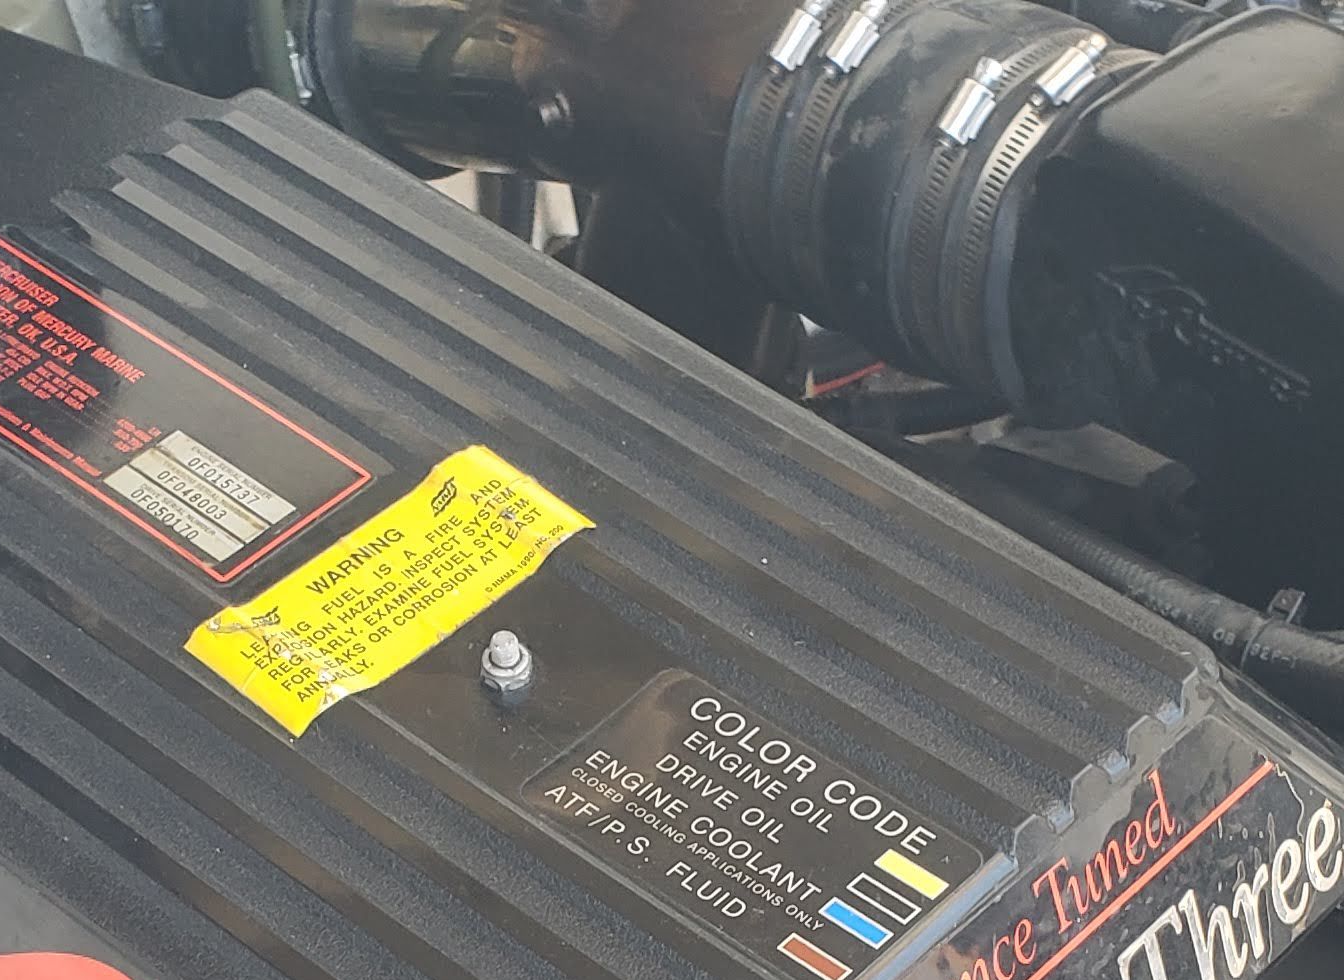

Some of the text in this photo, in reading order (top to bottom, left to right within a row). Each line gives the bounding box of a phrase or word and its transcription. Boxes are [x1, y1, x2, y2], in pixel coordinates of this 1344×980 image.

[13, 297, 37, 313] OF
[32, 310, 95, 350] MERCURY
[91, 347, 144, 382] MARINE
[39, 337, 78, 366] U.S.A.
[280, 666, 316, 691] FOR
[368, 625, 392, 643] OR
[392, 563, 478, 626] CORROSION
[479, 548, 498, 565] AT
[497, 507, 542, 548] LEAST
[305, 528, 405, 594] WARNING
[320, 586, 365, 615] FUEL
[372, 563, 392, 579] IS
[403, 550, 417, 560] A
[424, 515, 463, 543] FIRE
[470, 479, 502, 505] AND
[336, 581, 402, 624] HAZARD.
[400, 534, 461, 579] INSPECT
[462, 486, 517, 537] SYSTEM
[362, 576, 432, 626] EXAMINE
[431, 550, 474, 578] FUEL
[472, 497, 530, 549] SYSTEM
[585, 750, 822, 901] ENGINE COOLANT
[655, 753, 784, 844] DRIVE OIL
[683, 730, 833, 833] ENGINE OIL
[690, 697, 937, 855] COLOR CODE
[571, 767, 825, 931] CLOSED COOLING APPLICATIONS ONLY
[665, 861, 747, 918] FLUID
[1032, 770, 1175, 933] Tuned
